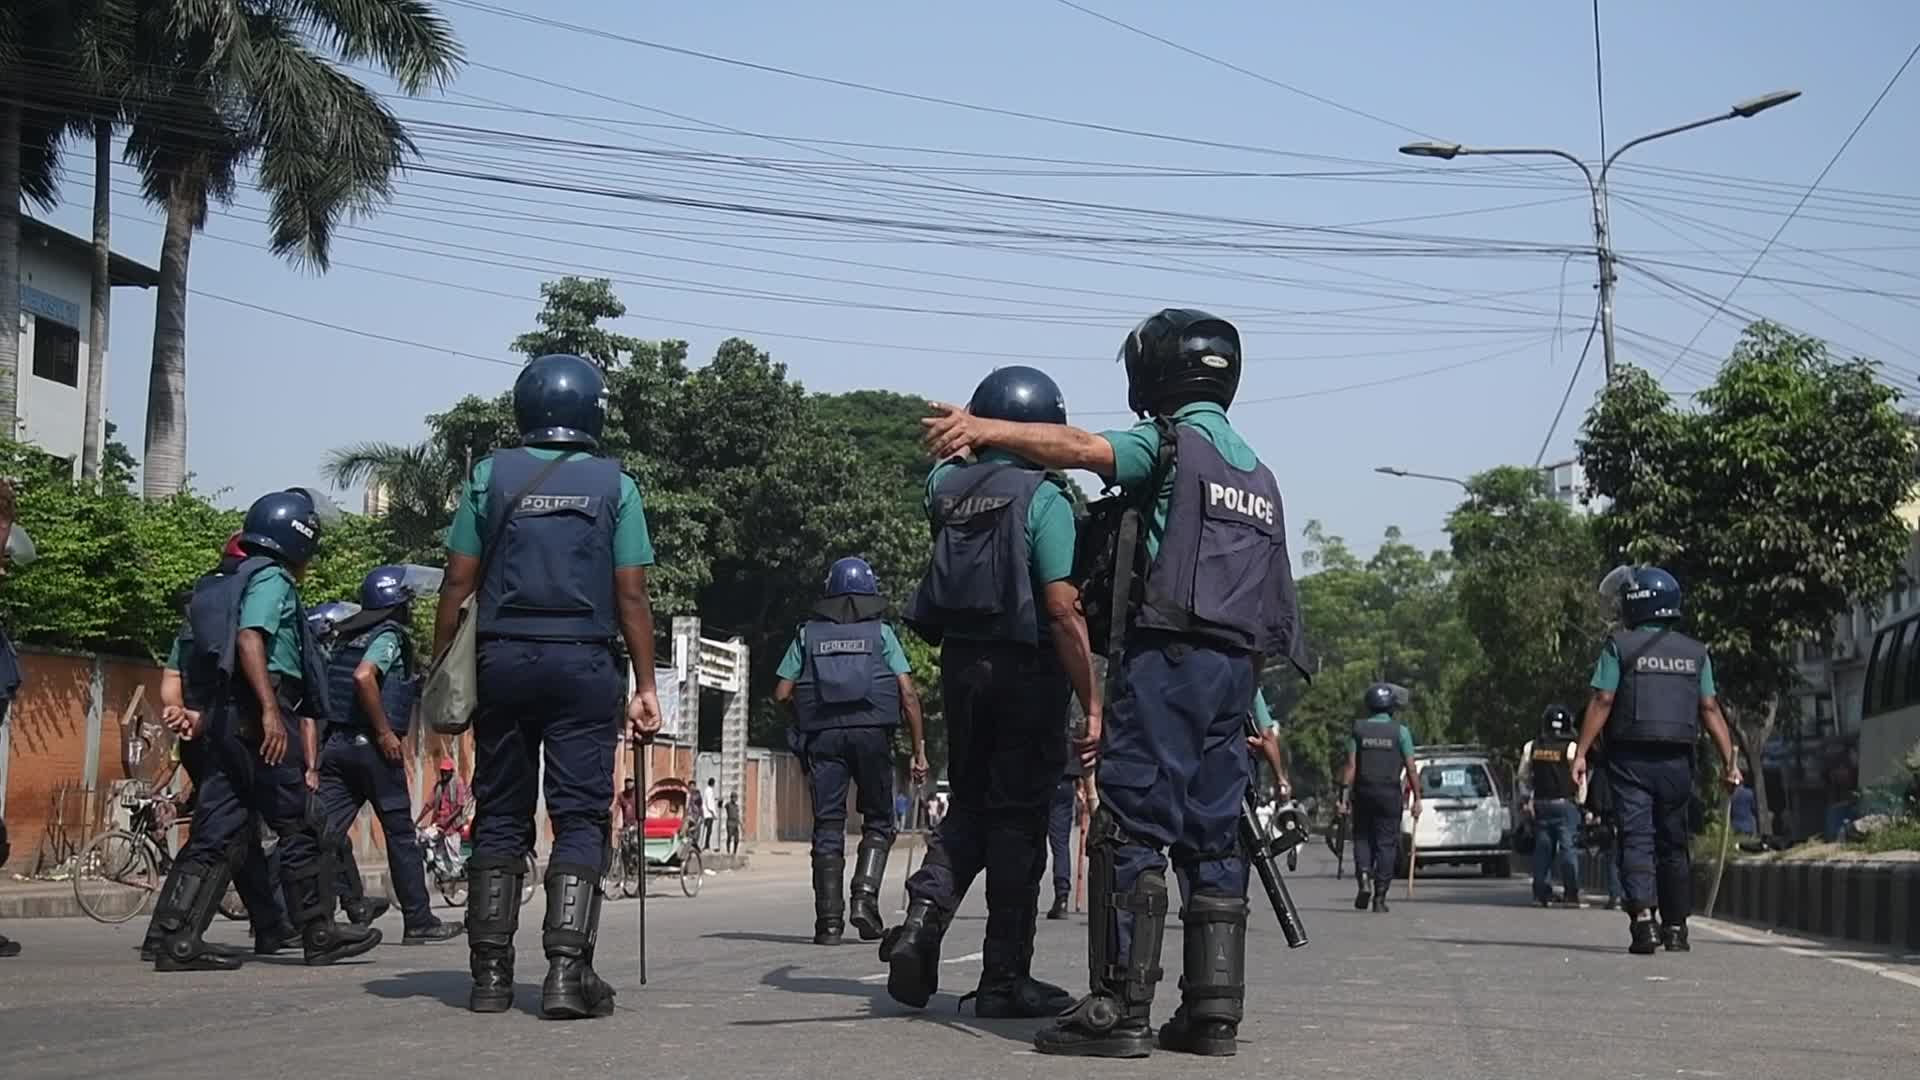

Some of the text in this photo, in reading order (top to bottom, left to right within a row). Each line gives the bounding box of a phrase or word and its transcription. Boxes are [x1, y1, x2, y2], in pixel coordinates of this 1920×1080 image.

[521, 497, 577, 509] POLIC
[1210, 482, 1273, 525] POLICE
[1637, 656, 1697, 672] POLICE
